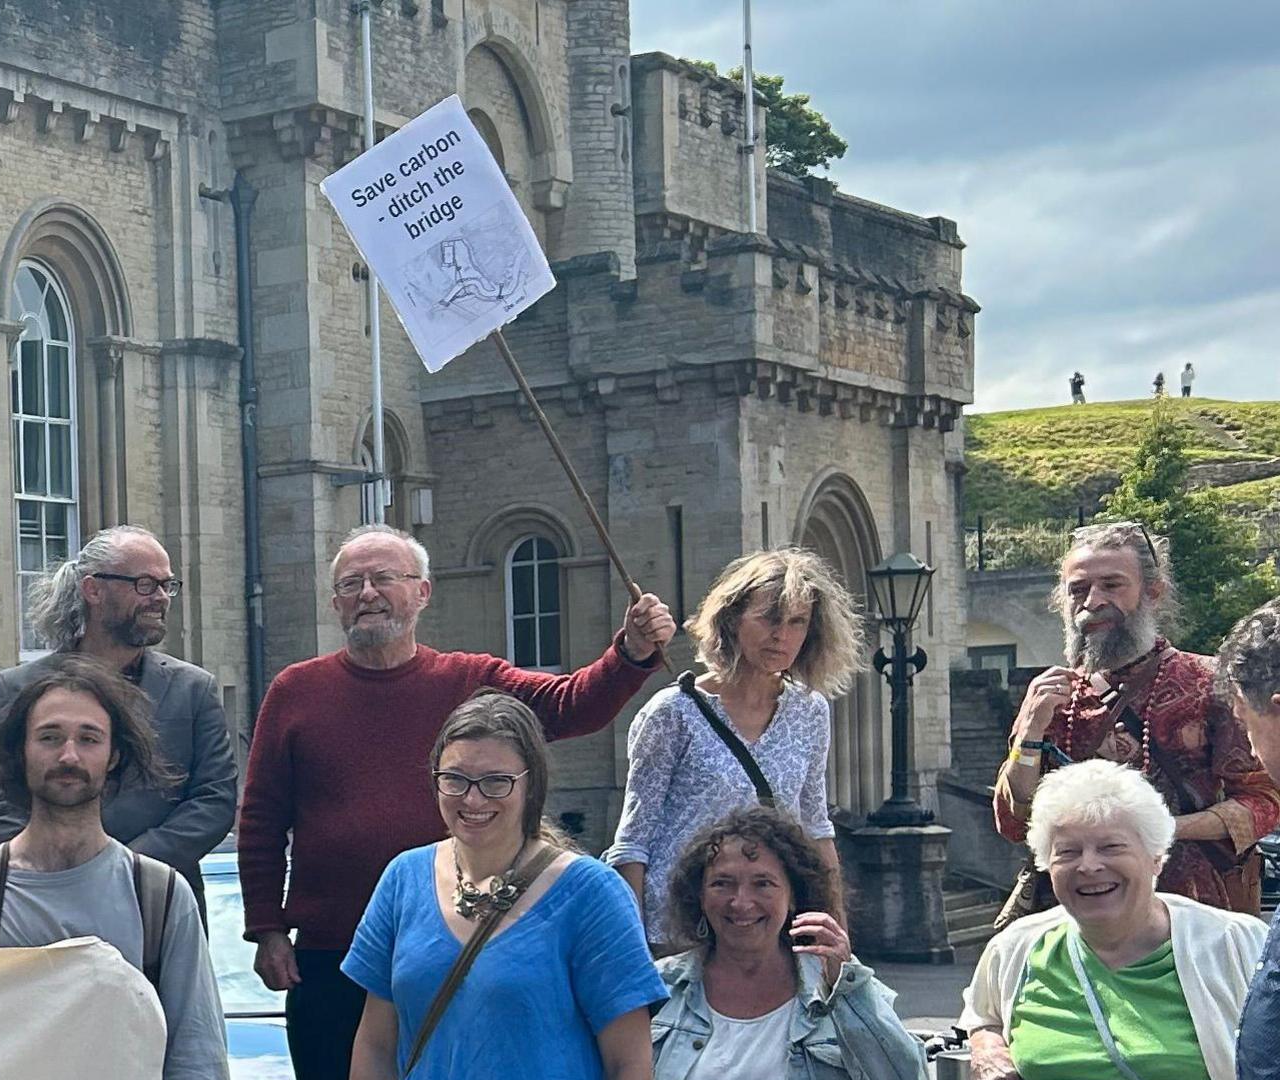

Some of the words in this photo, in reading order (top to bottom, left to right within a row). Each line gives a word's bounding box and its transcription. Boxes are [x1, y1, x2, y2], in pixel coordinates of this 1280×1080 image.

[351, 172, 396, 208] Save
[399, 130, 461, 177] carbon
[388, 180, 434, 220] ditch
[434, 160, 465, 189] the
[404, 197, 463, 240] bridge
